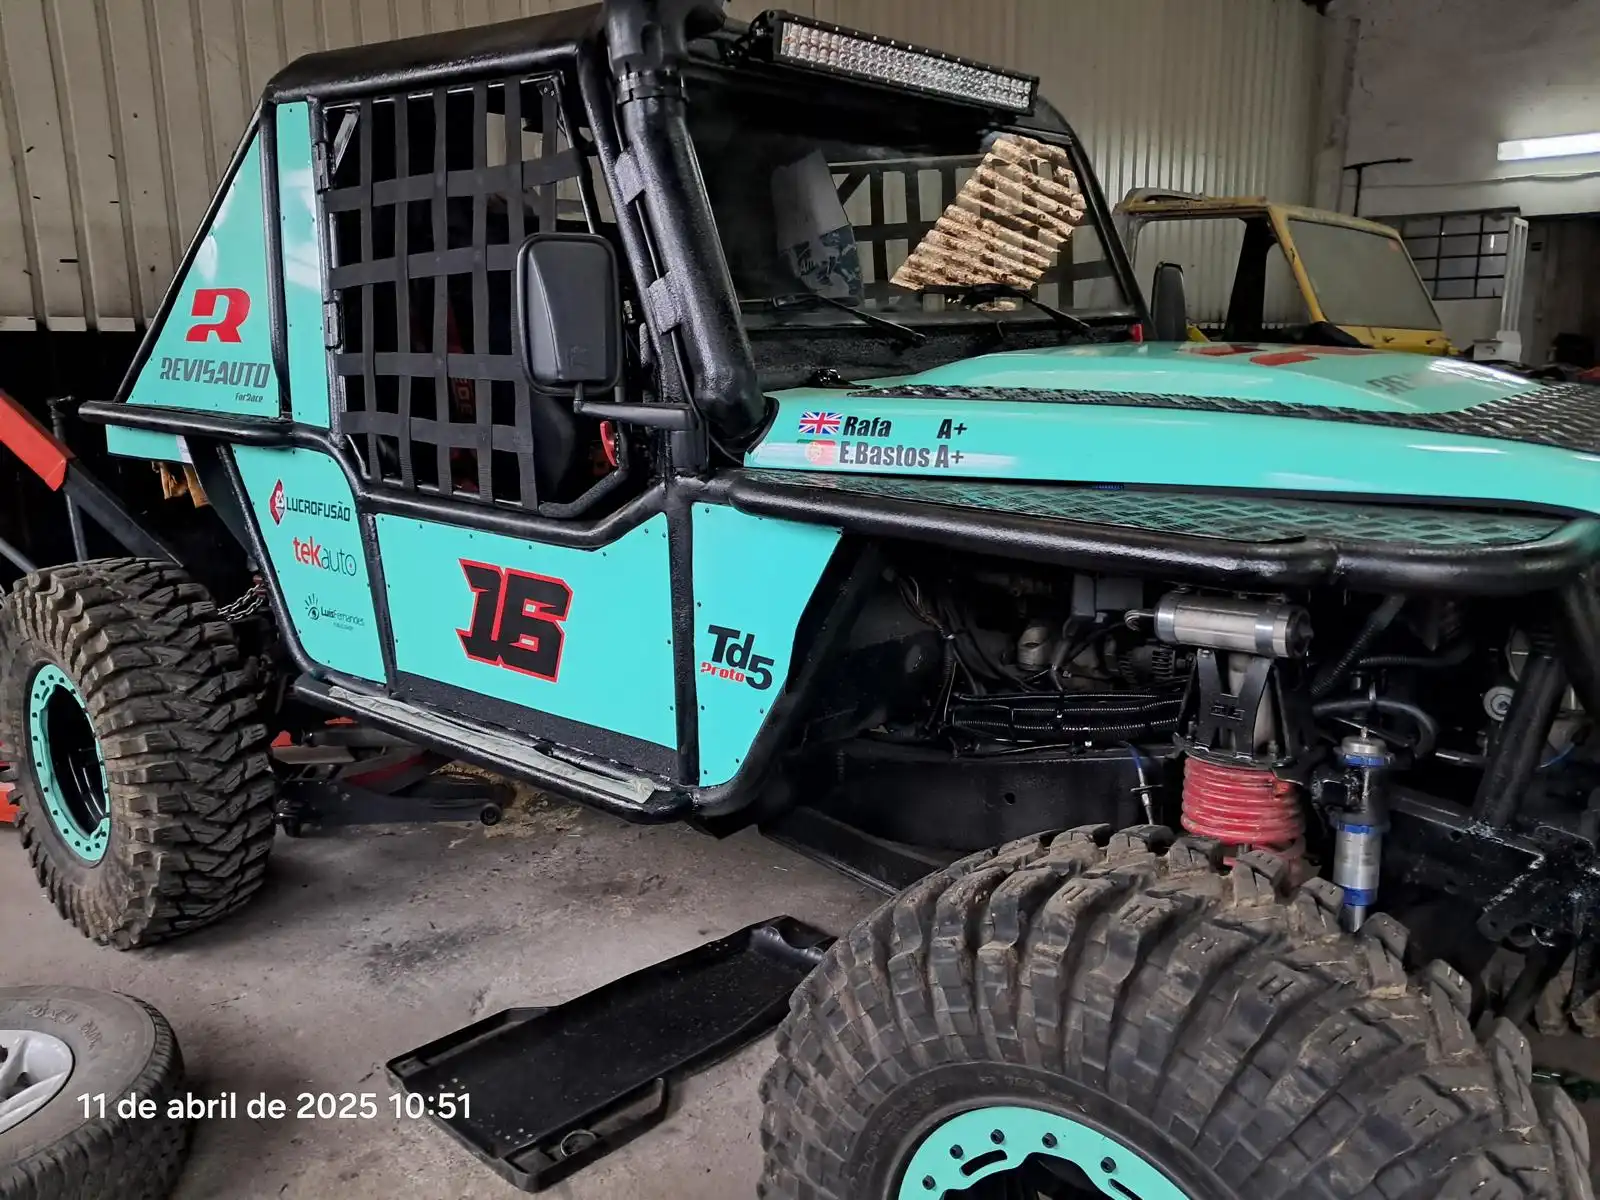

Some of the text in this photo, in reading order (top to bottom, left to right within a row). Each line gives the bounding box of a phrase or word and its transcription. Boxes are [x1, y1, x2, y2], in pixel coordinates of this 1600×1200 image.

[159, 356, 271, 389] REVISAUTO
[843, 415, 968, 440] Rafa A+
[839, 441, 965, 469] E.Bastos A+
[286, 496, 351, 523] LUCROFUSÃO
[454, 557, 574, 684] 16
[700, 661, 745, 682] Proto
[707, 624, 775, 691] Td5
